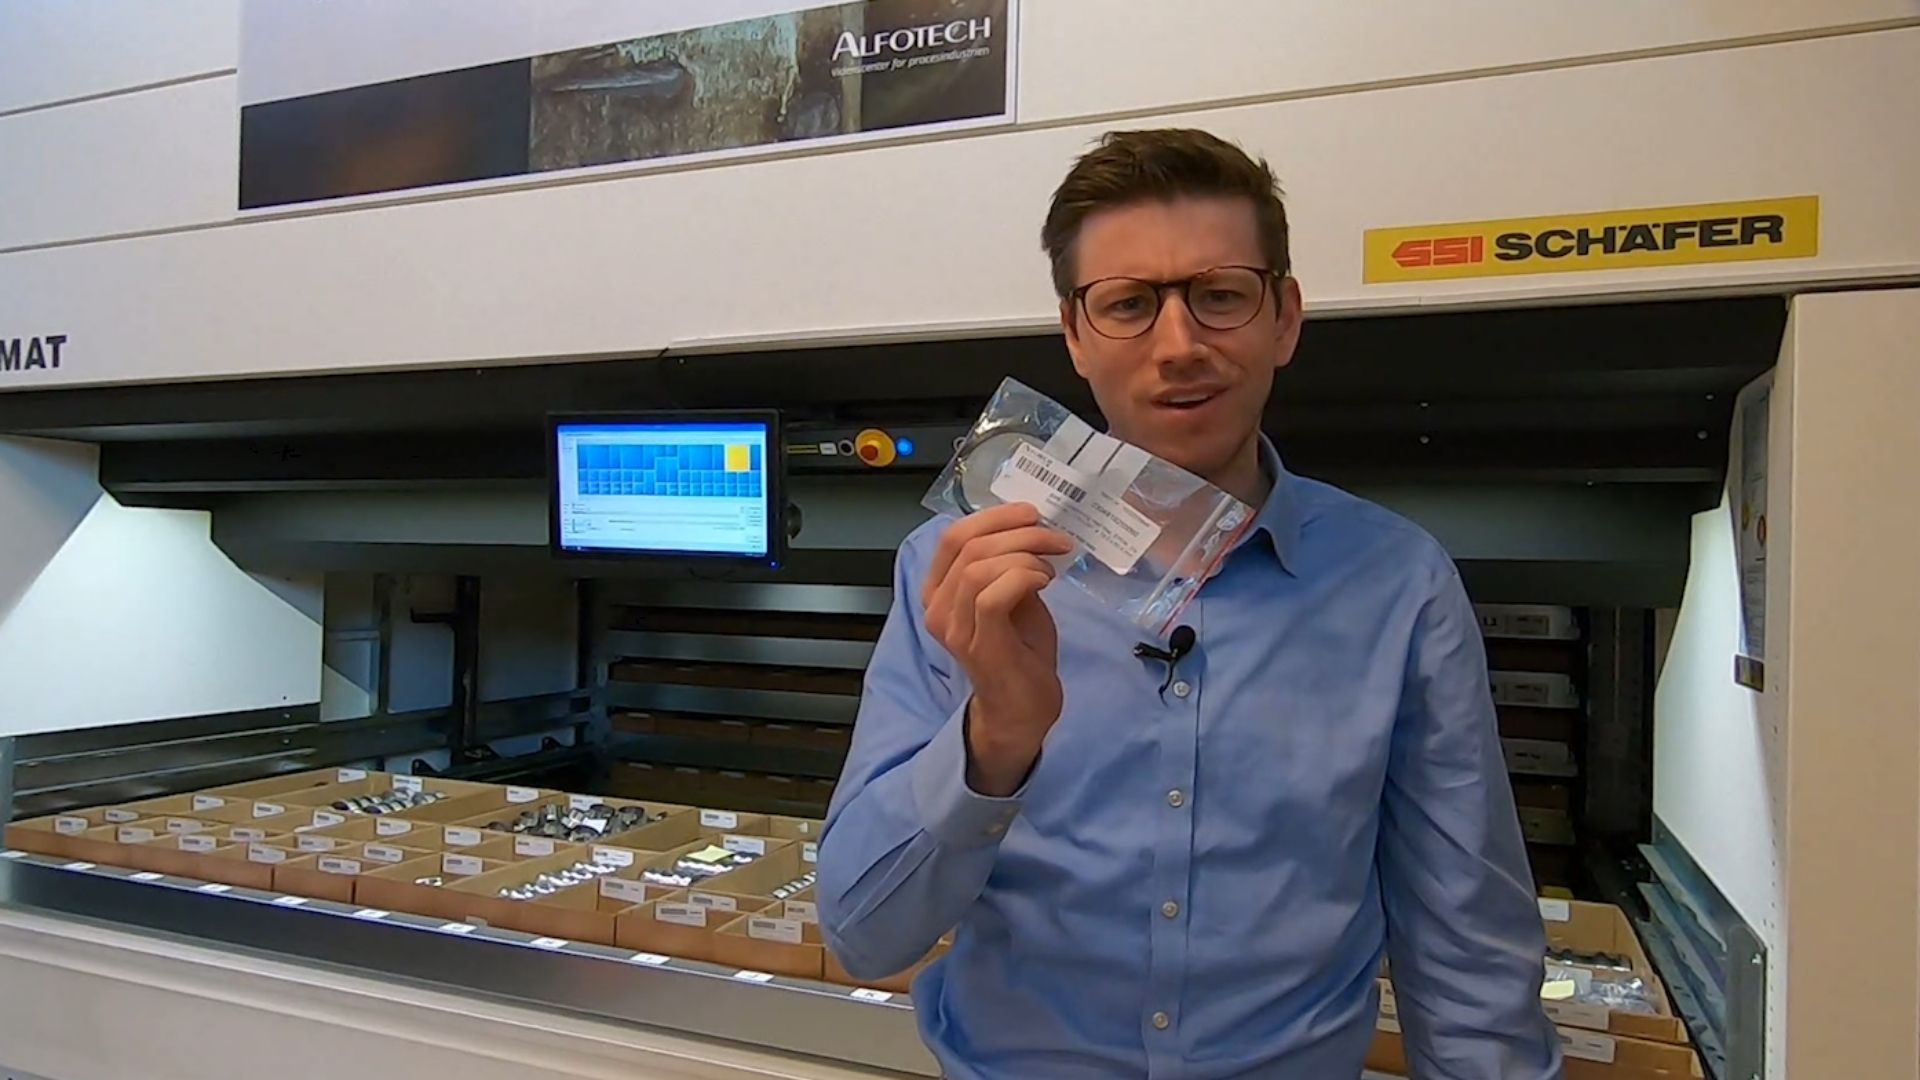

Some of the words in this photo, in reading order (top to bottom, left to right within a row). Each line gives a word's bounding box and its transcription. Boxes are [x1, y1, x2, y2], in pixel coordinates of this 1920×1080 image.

[832, 16, 991, 61] ALFOTECH
[890, 58, 906, 72] for
[1391, 236, 1484, 267] SSI
[1494, 214, 1784, 261] SCHÄFER
[0, 334, 68, 371] MAT
